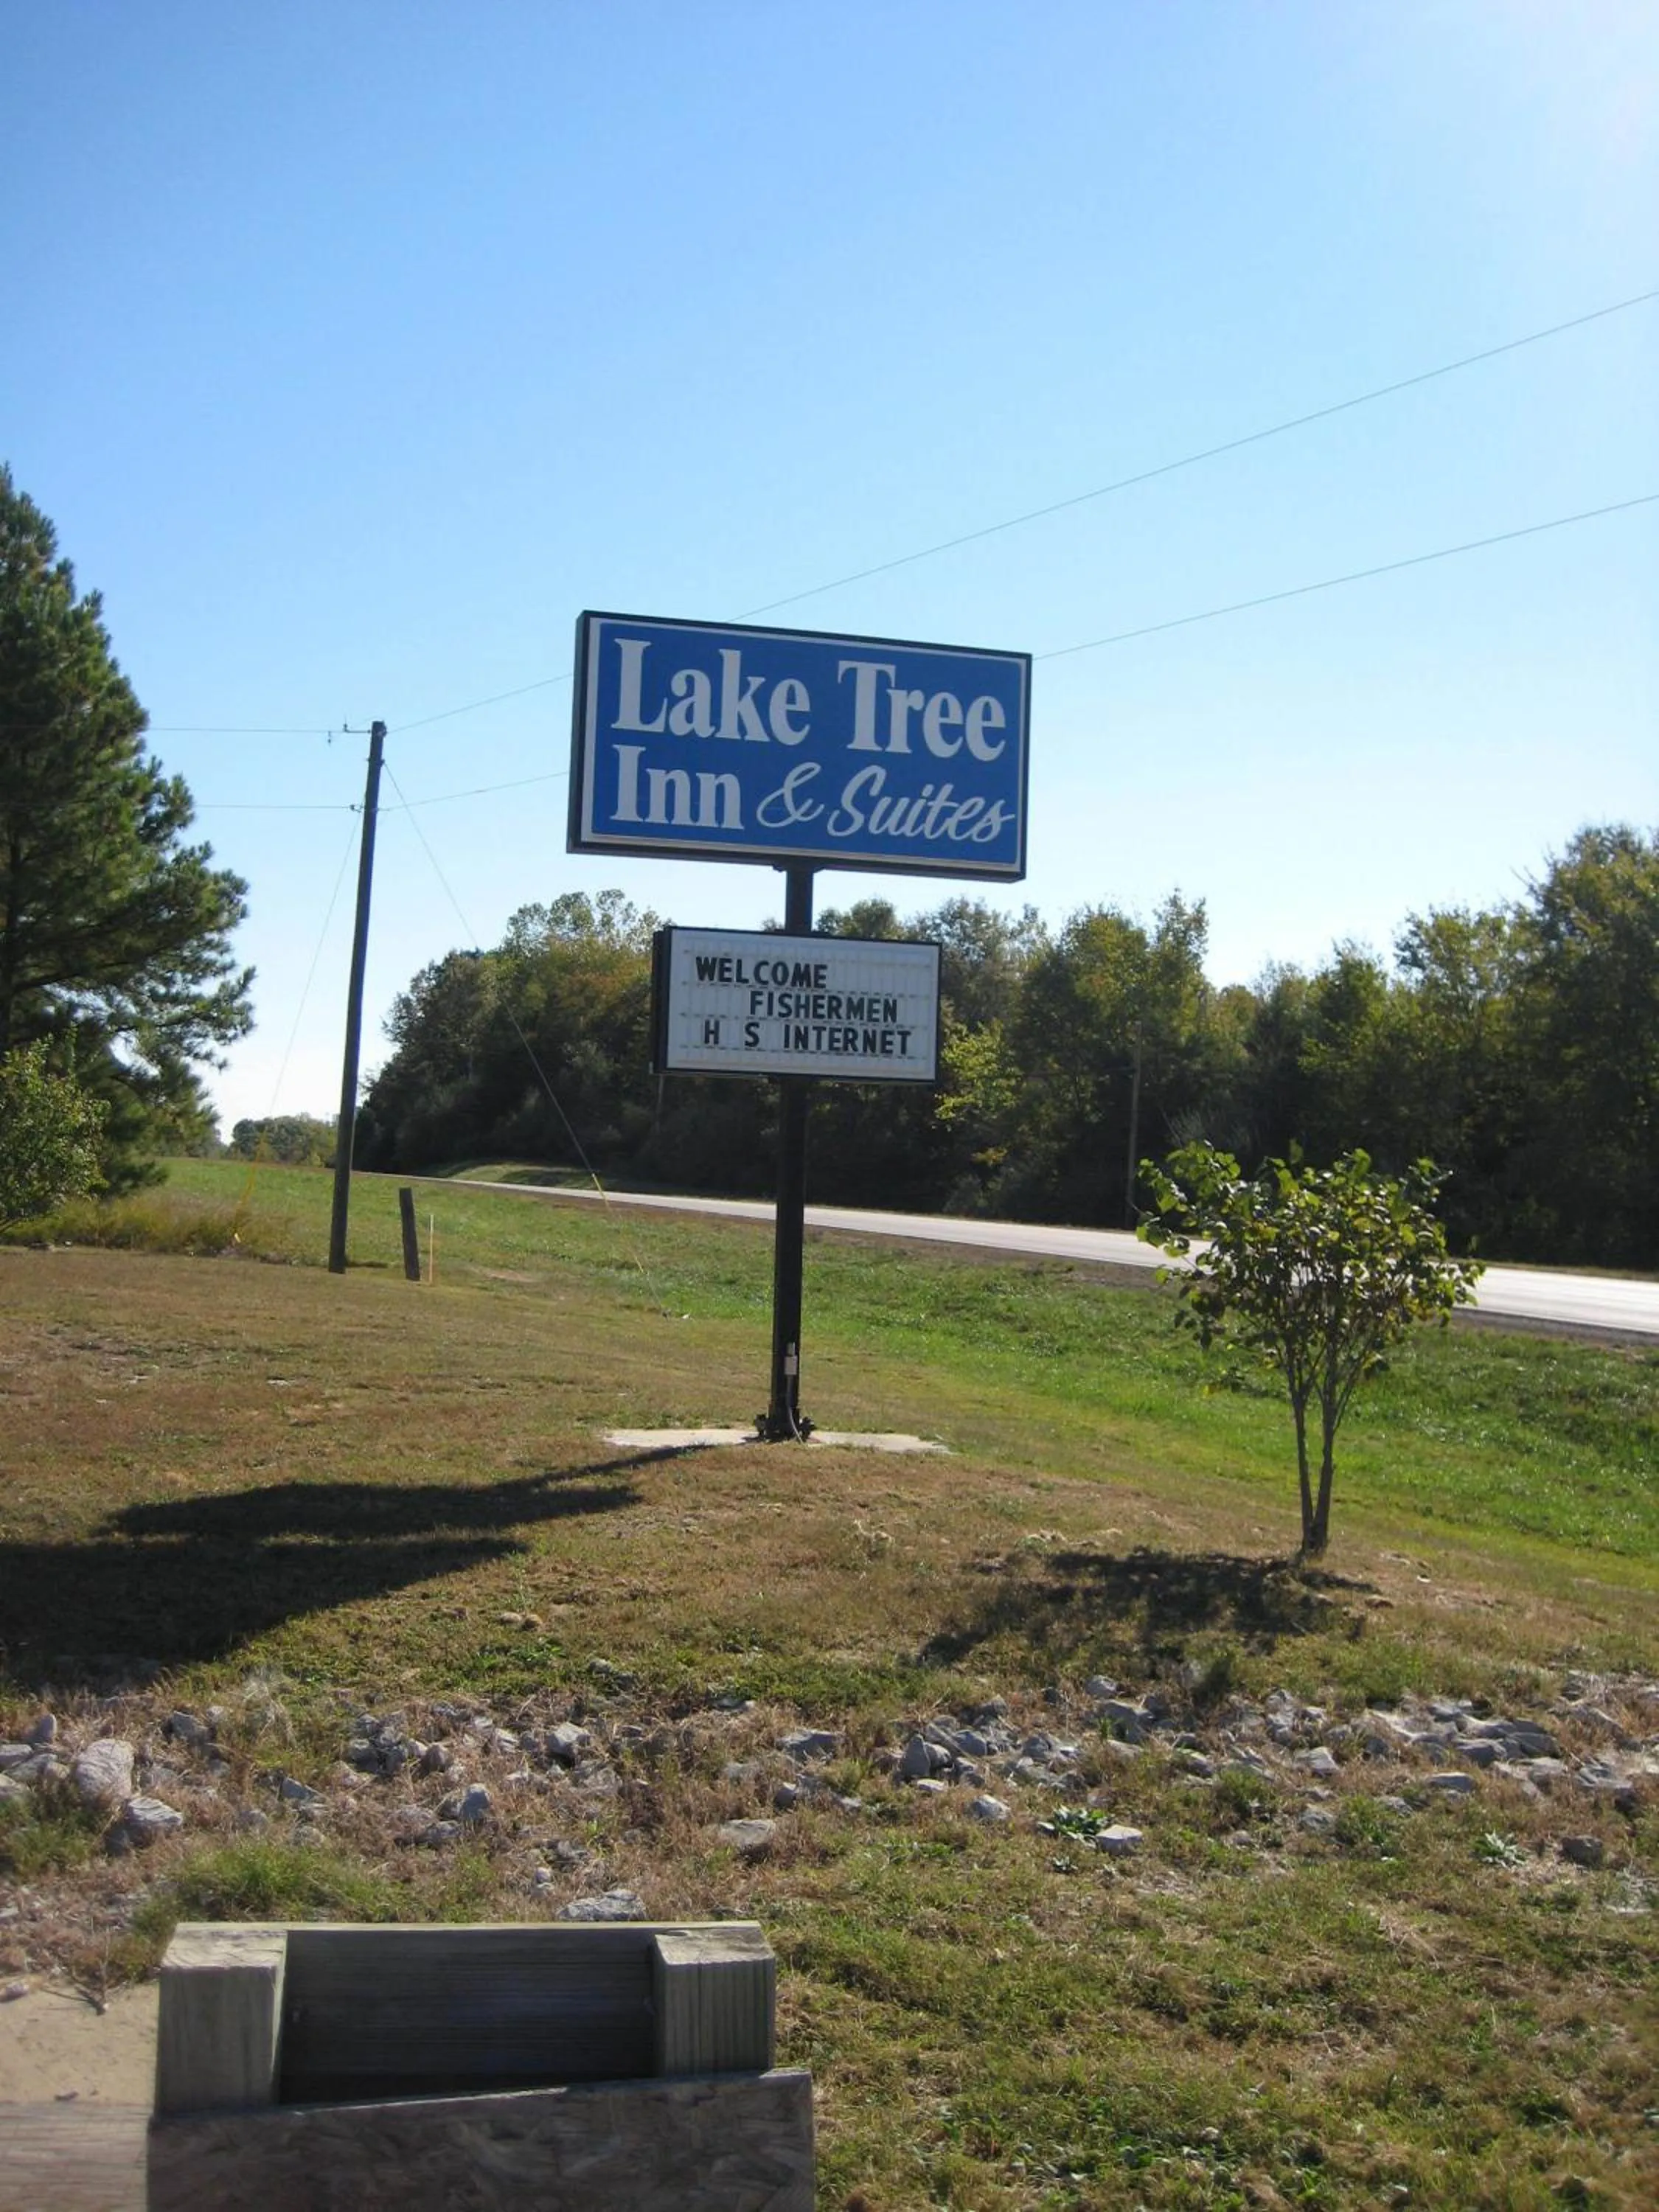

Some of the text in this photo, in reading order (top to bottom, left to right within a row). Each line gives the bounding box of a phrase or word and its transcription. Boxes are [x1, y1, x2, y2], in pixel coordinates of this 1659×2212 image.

[611, 638, 1006, 762] Lake Tree
[610, 744, 1015, 843] Inn & Suites
[695, 956, 828, 989] WELCOME
[750, 990, 897, 1023] FISHERMEN
[783, 1023, 911, 1055] INTERNET
